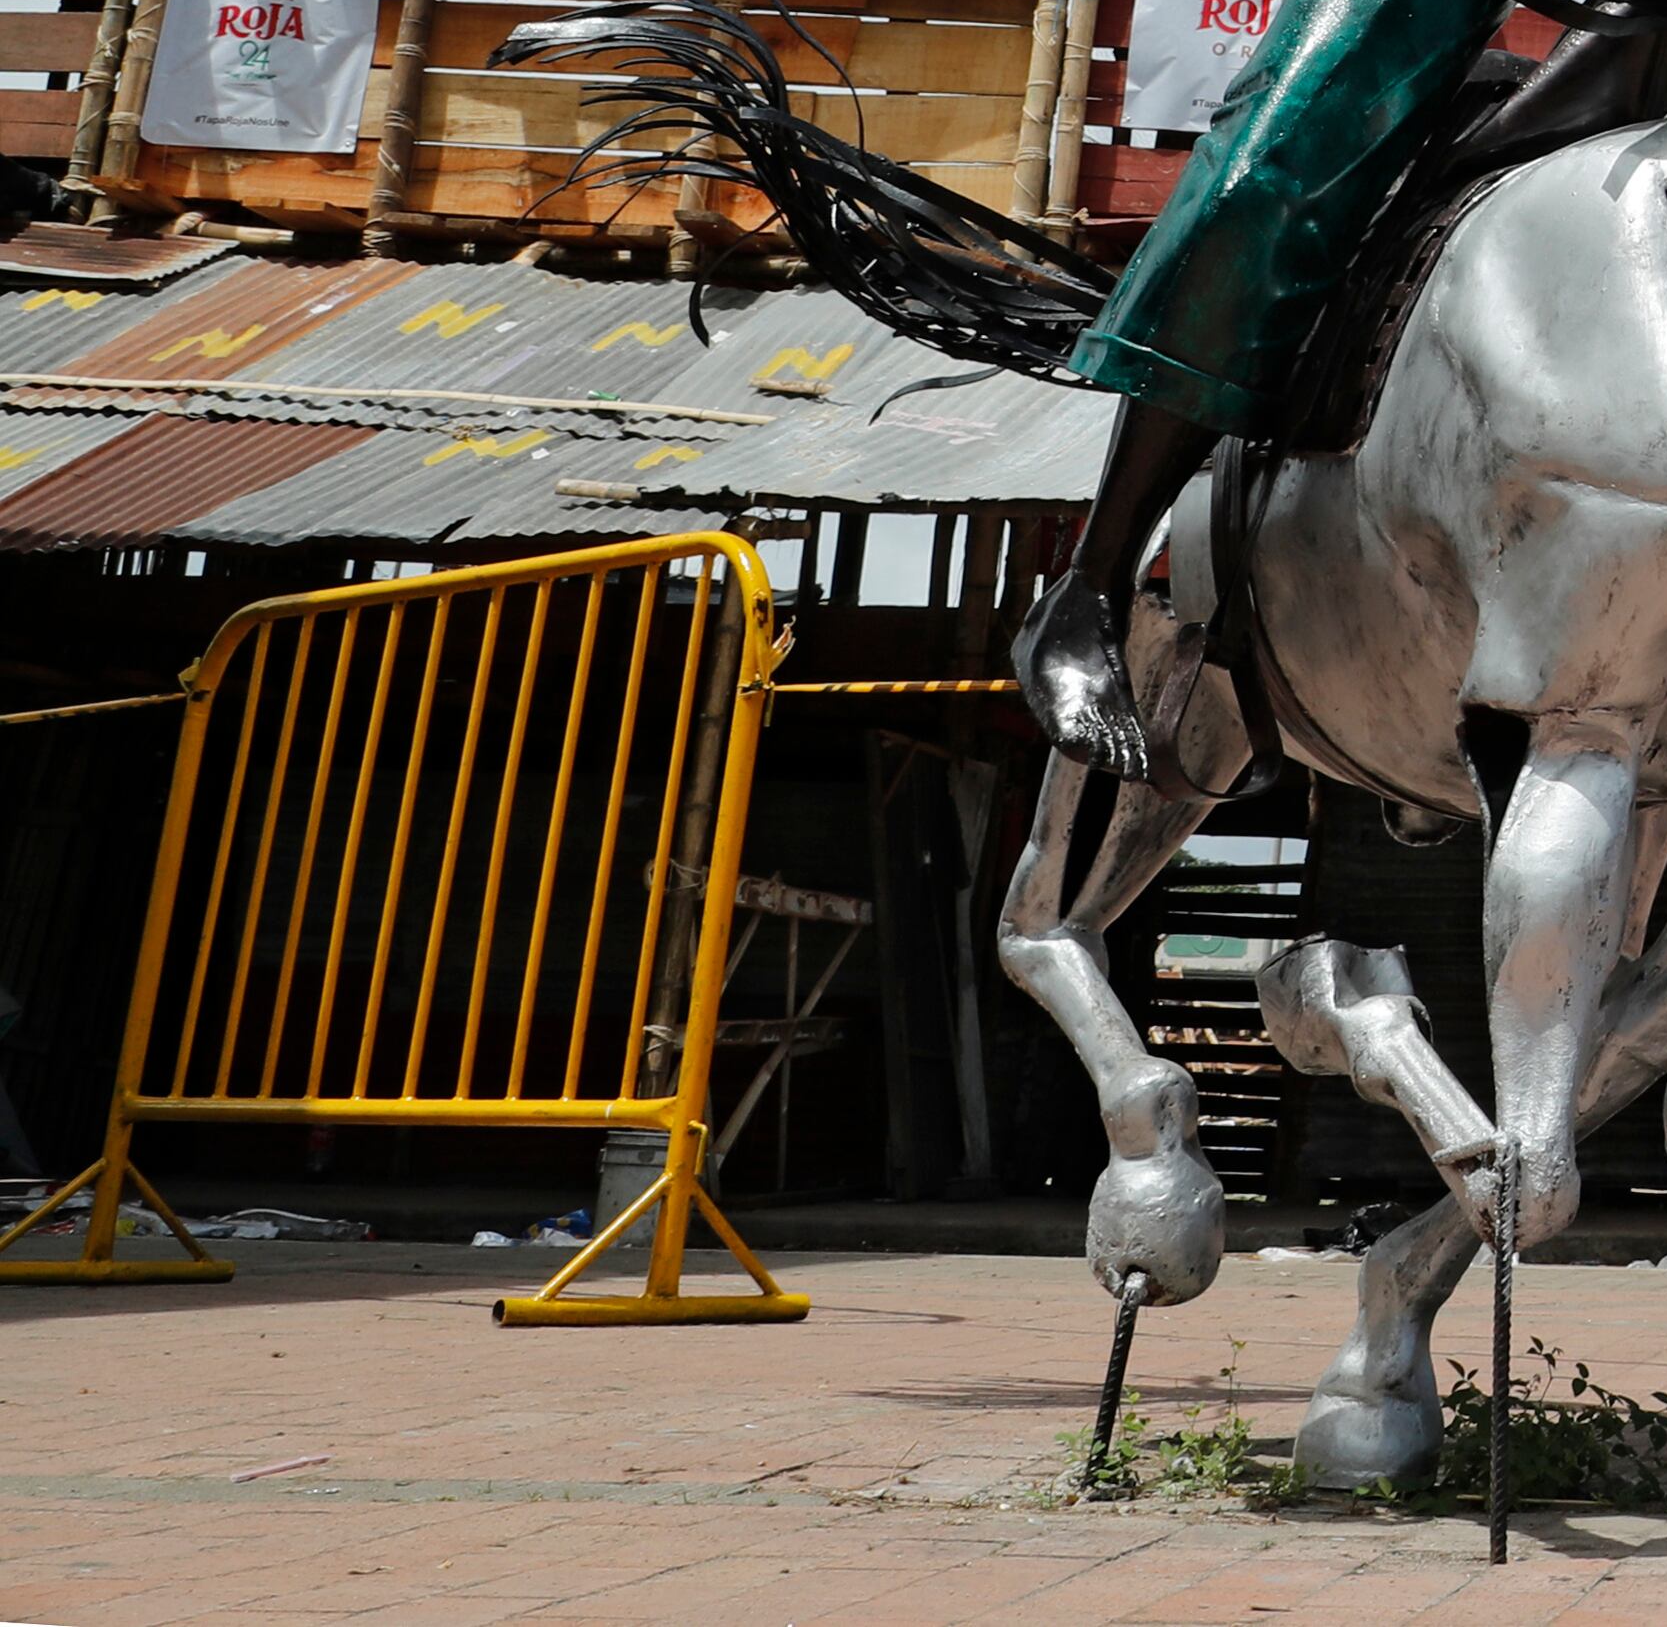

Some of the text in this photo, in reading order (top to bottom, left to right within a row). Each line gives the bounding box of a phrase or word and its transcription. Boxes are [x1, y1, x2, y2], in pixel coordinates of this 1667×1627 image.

[215, 3, 306, 41] ROJA
[238, 40, 271, 70] 24
[194, 115, 290, 127] #TapaRojaNosUne
